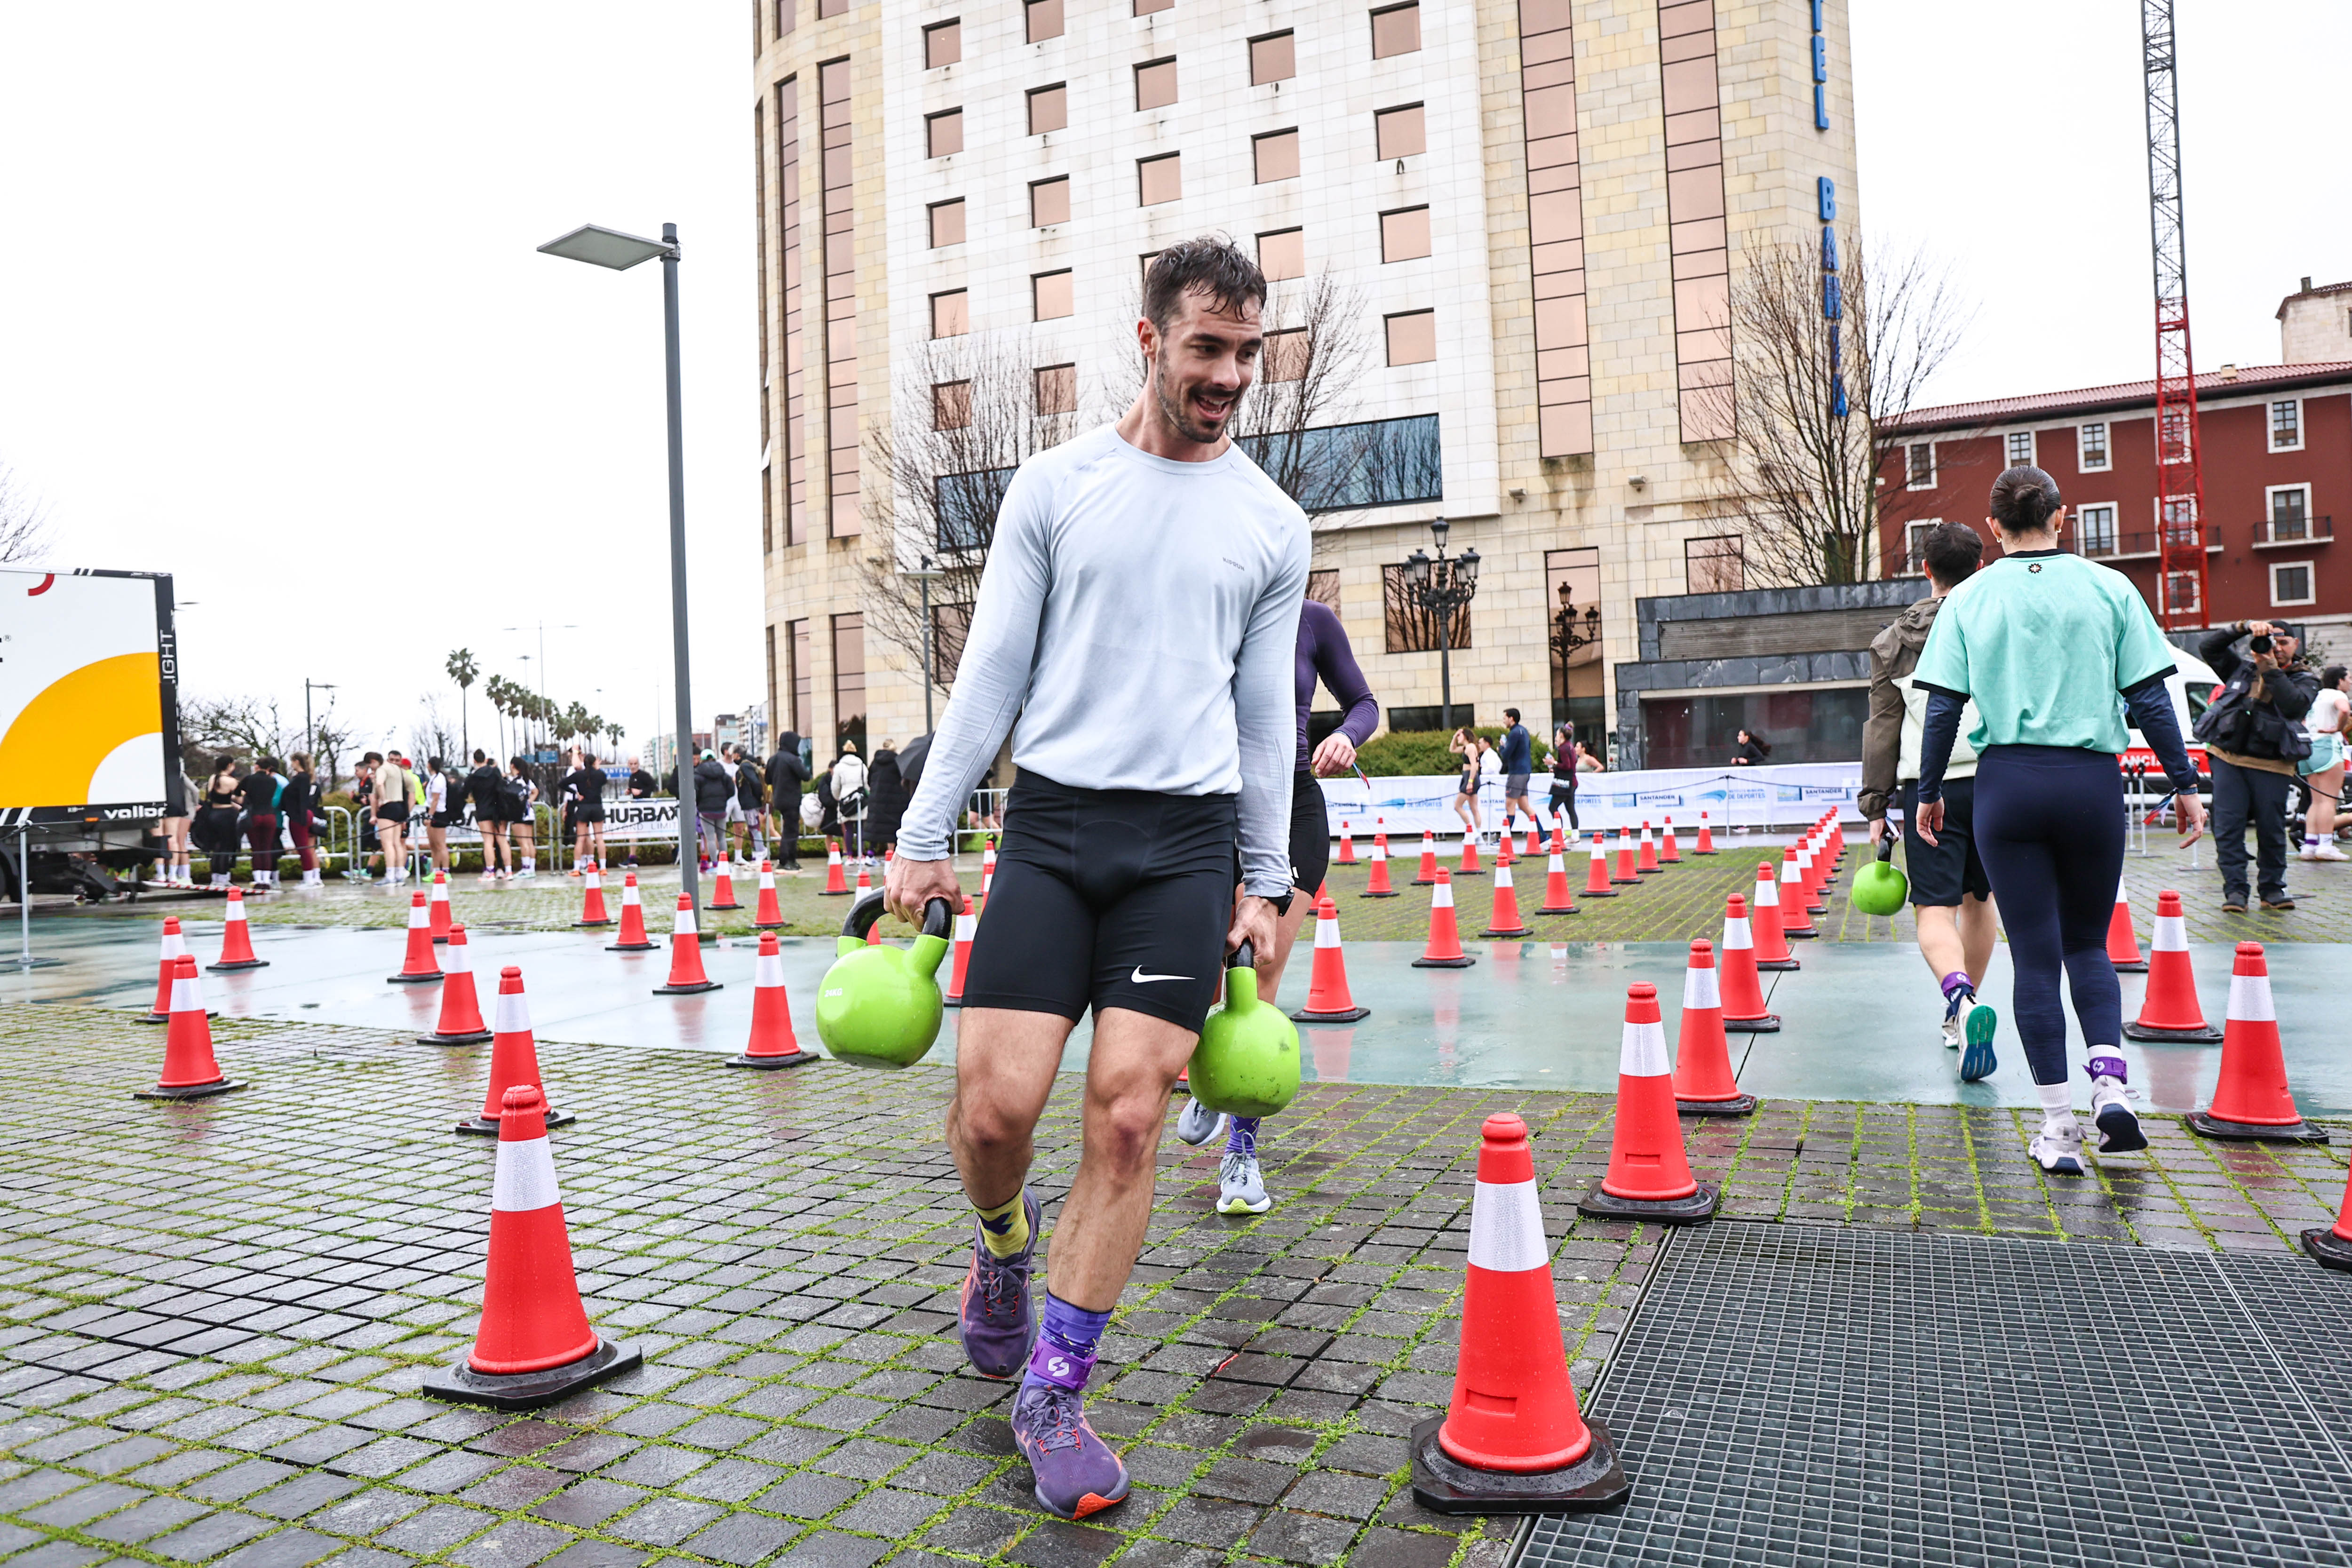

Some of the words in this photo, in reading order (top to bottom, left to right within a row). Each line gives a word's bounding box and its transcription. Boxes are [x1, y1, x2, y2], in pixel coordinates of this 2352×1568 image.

[1223, 557, 1245, 572] KIPRUN
[160, 629, 177, 684] IGHT
[824, 987, 843, 997] 24KG
